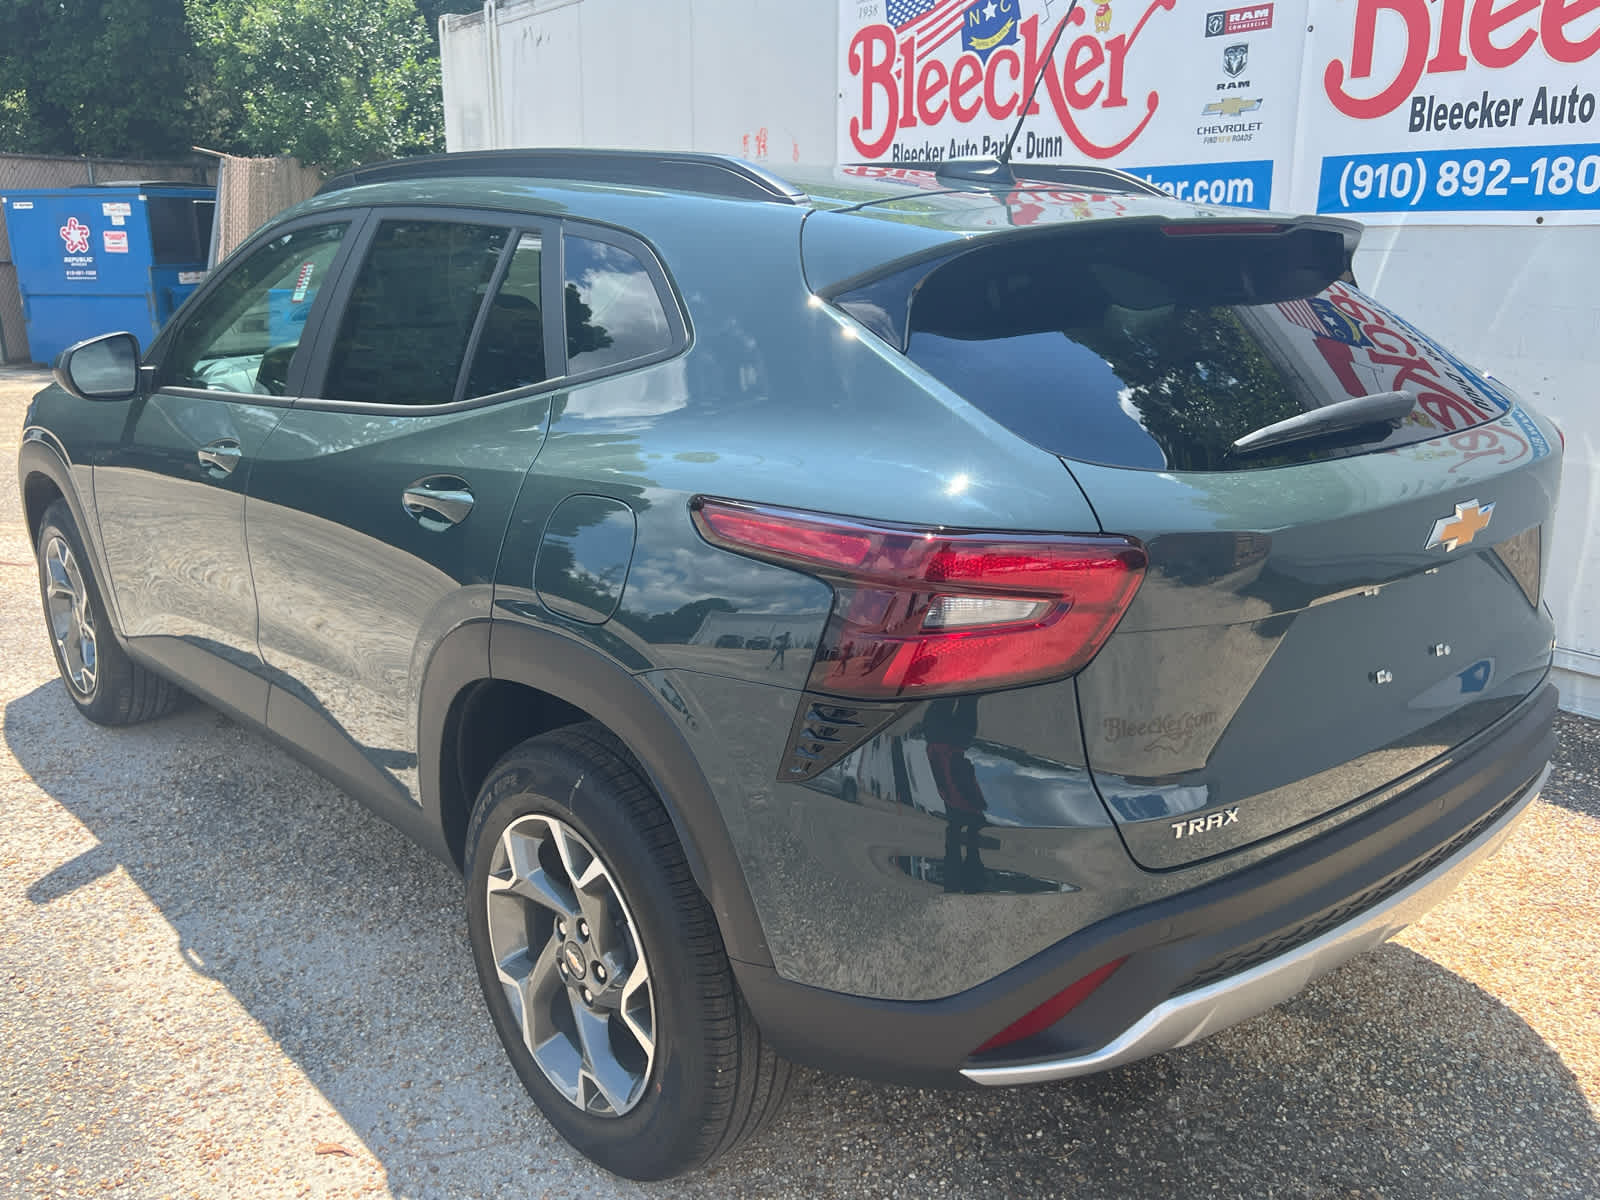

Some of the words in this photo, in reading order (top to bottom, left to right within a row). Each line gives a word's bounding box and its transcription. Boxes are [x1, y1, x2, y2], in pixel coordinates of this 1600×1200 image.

[1228, 21, 1269, 31] COMMERCIAL
[1229, 8, 1269, 22] RAM
[848, 0, 1176, 160] Bleecker
[1216, 80, 1251, 91] RAM
[1408, 91, 1524, 132] Bleecker
[1528, 85, 1596, 126] Auto
[1197, 122, 1263, 135] CHEVROLET
[949, 137, 978, 159] Auto
[1025, 131, 1063, 159] Dunn
[1339, 157, 1427, 207] (910)
[1435, 155, 1600, 198] 892-180
[1171, 808, 1240, 839] TRAX
